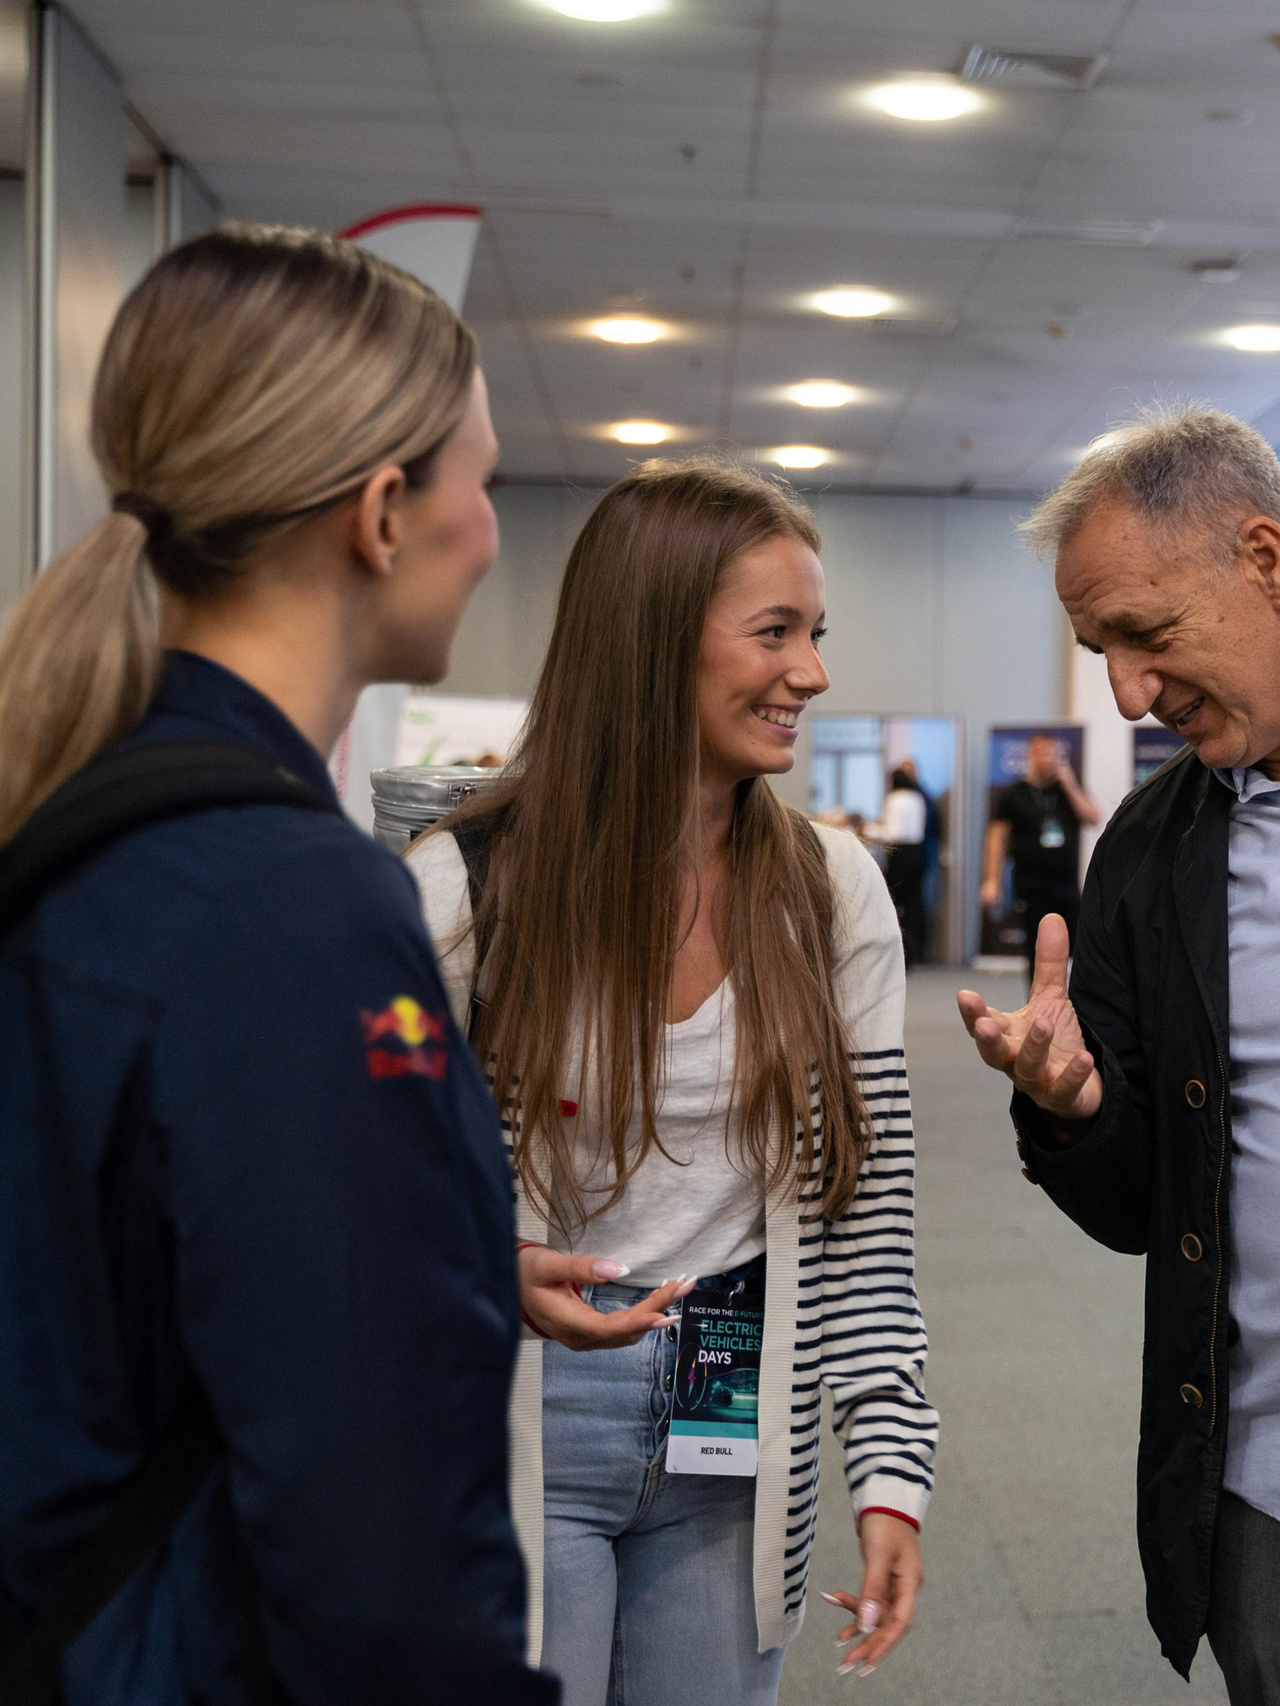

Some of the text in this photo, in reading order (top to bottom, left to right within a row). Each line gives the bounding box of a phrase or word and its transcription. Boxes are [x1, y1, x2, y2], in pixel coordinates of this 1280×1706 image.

[689, 1306, 706, 1315] RACE
[707, 1307, 721, 1316] FOR
[722, 1308, 734, 1317] THE
[701, 1319, 762, 1336] ELECTRIC
[700, 1334, 761, 1352] VEHICLES
[698, 1349, 732, 1365] DAYS
[700, 1446, 733, 1456] RED BULL
